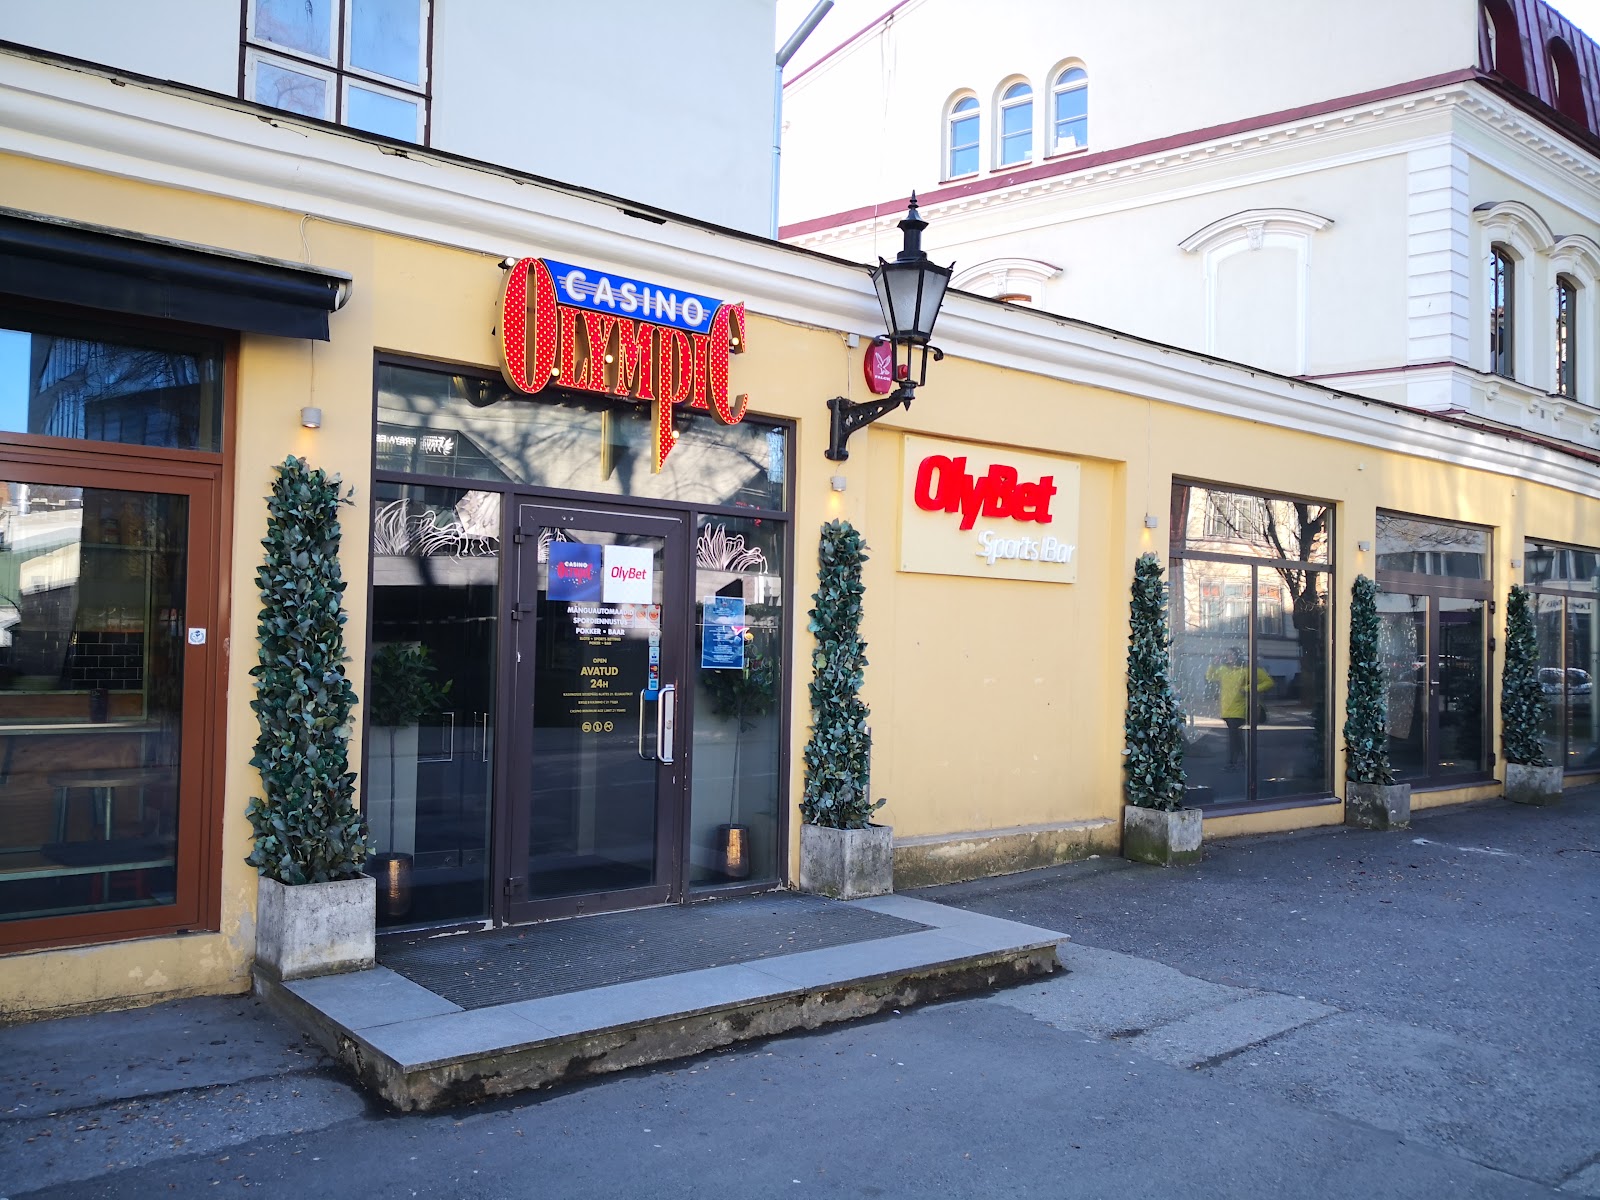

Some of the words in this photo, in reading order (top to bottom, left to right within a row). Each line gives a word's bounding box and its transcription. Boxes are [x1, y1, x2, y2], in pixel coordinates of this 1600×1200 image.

[565, 269, 704, 327] CASINO
[500, 256, 748, 474] OLYMPIC
[914, 454, 1058, 531] OlyBet
[976, 530, 1039, 565] Sports
[1039, 536, 1075, 564] Bar
[564, 561, 588, 569] CASINO
[611, 566, 647, 582] OlyBet
[575, 627, 602, 635] POKKER
[607, 628, 626, 636] BAAR
[580, 666, 619, 676] AVATUD
[590, 678, 609, 689] 24H
